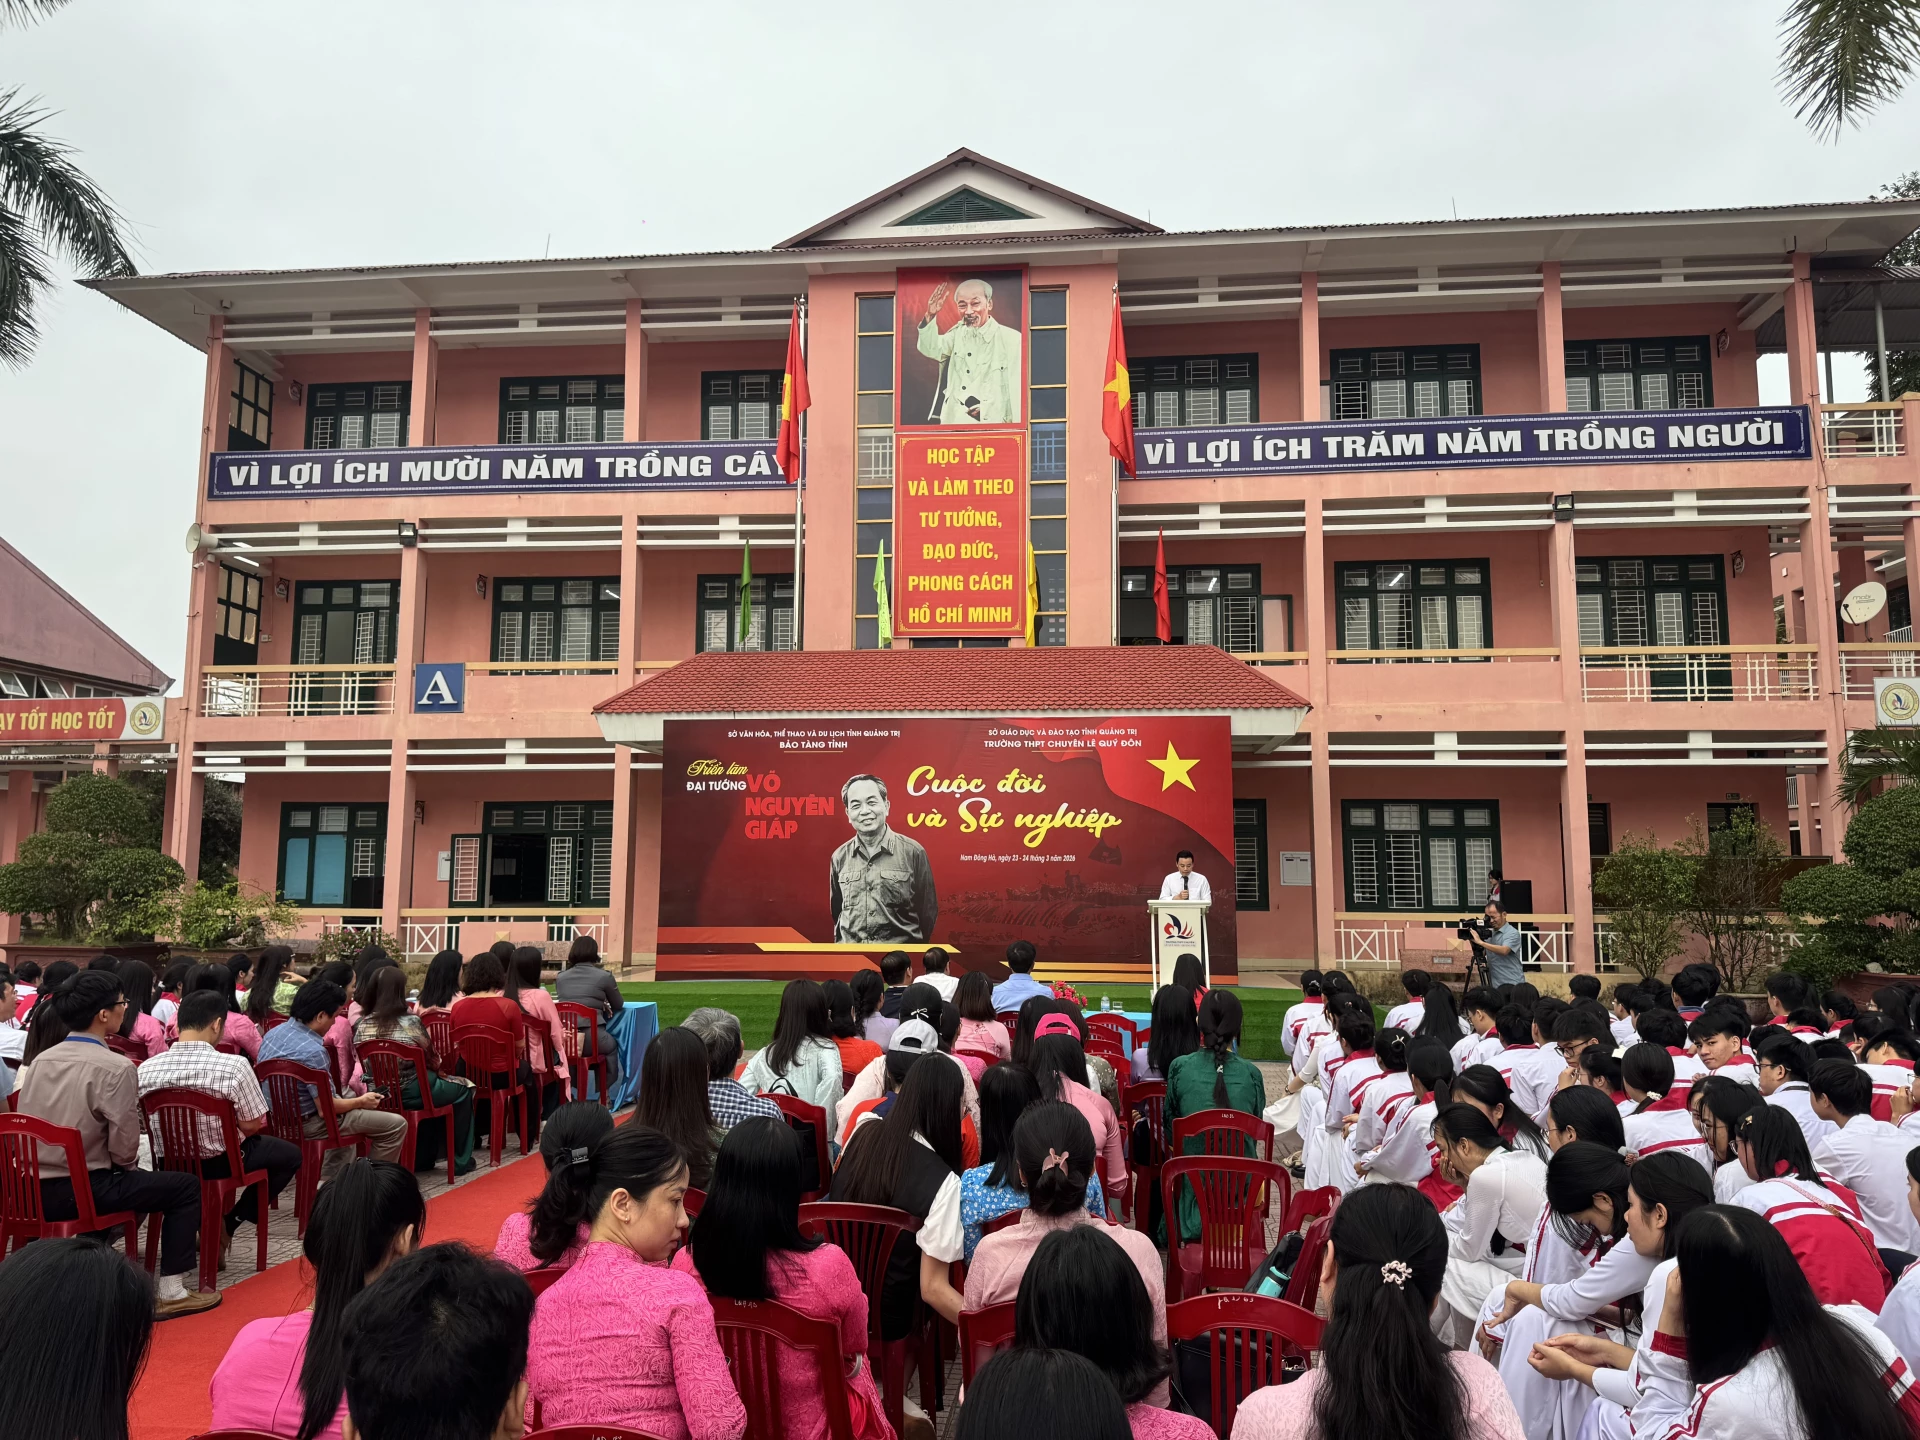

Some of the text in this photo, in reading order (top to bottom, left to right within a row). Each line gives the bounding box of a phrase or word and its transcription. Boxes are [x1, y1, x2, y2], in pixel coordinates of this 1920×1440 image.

[1144, 418, 1783, 467] VÌ LỢI ÍCH TRĂM NĂM TRỒNG NGƯỜI
[927, 445, 995, 467] HỌC TẬP
[229, 462, 259, 486] VÌ
[271, 463, 321, 488] LỢI
[333, 459, 388, 483] ÍCH
[401, 455, 490, 482] MƯỜI
[502, 454, 583, 479] NĂM
[596, 450, 711, 478] TRỒNG
[908, 477, 1014, 496] VÀ LÀM THEO
[920, 506, 1002, 528] TƯ TƯỞNG,
[923, 540, 998, 562] ĐẠO ĐỨC,
[909, 572, 1013, 591] PHONG CÁCH
[909, 602, 1012, 623] HỒ CHÍ MINH
[418, 671, 458, 704] A
[20, 706, 47, 730] TỐT
[51, 712, 82, 733] HỌC
[88, 705, 115, 729] TỐT
[755, 730, 772, 738] HÓA,
[1099, 727, 1125, 735] QUẢNG
[780, 739, 847, 748] BẢO TÀNG TỈNH
[984, 739, 1021, 747] TRƯỜNG
[1048, 739, 1084, 747] CHUYÊN
[1087, 739, 1095, 747] LÊ
[1099, 739, 1118, 747] QUÝ
[687, 759, 748, 776] Triển lãm
[687, 779, 746, 793] ĐẠI TƯỚNG
[746, 770, 781, 792] VÕ
[906, 765, 1046, 798] Cuộc đời
[746, 794, 834, 816] NGUYÊN
[745, 817, 798, 839] GIÁP
[907, 797, 1122, 848] và Sự nghiệp
